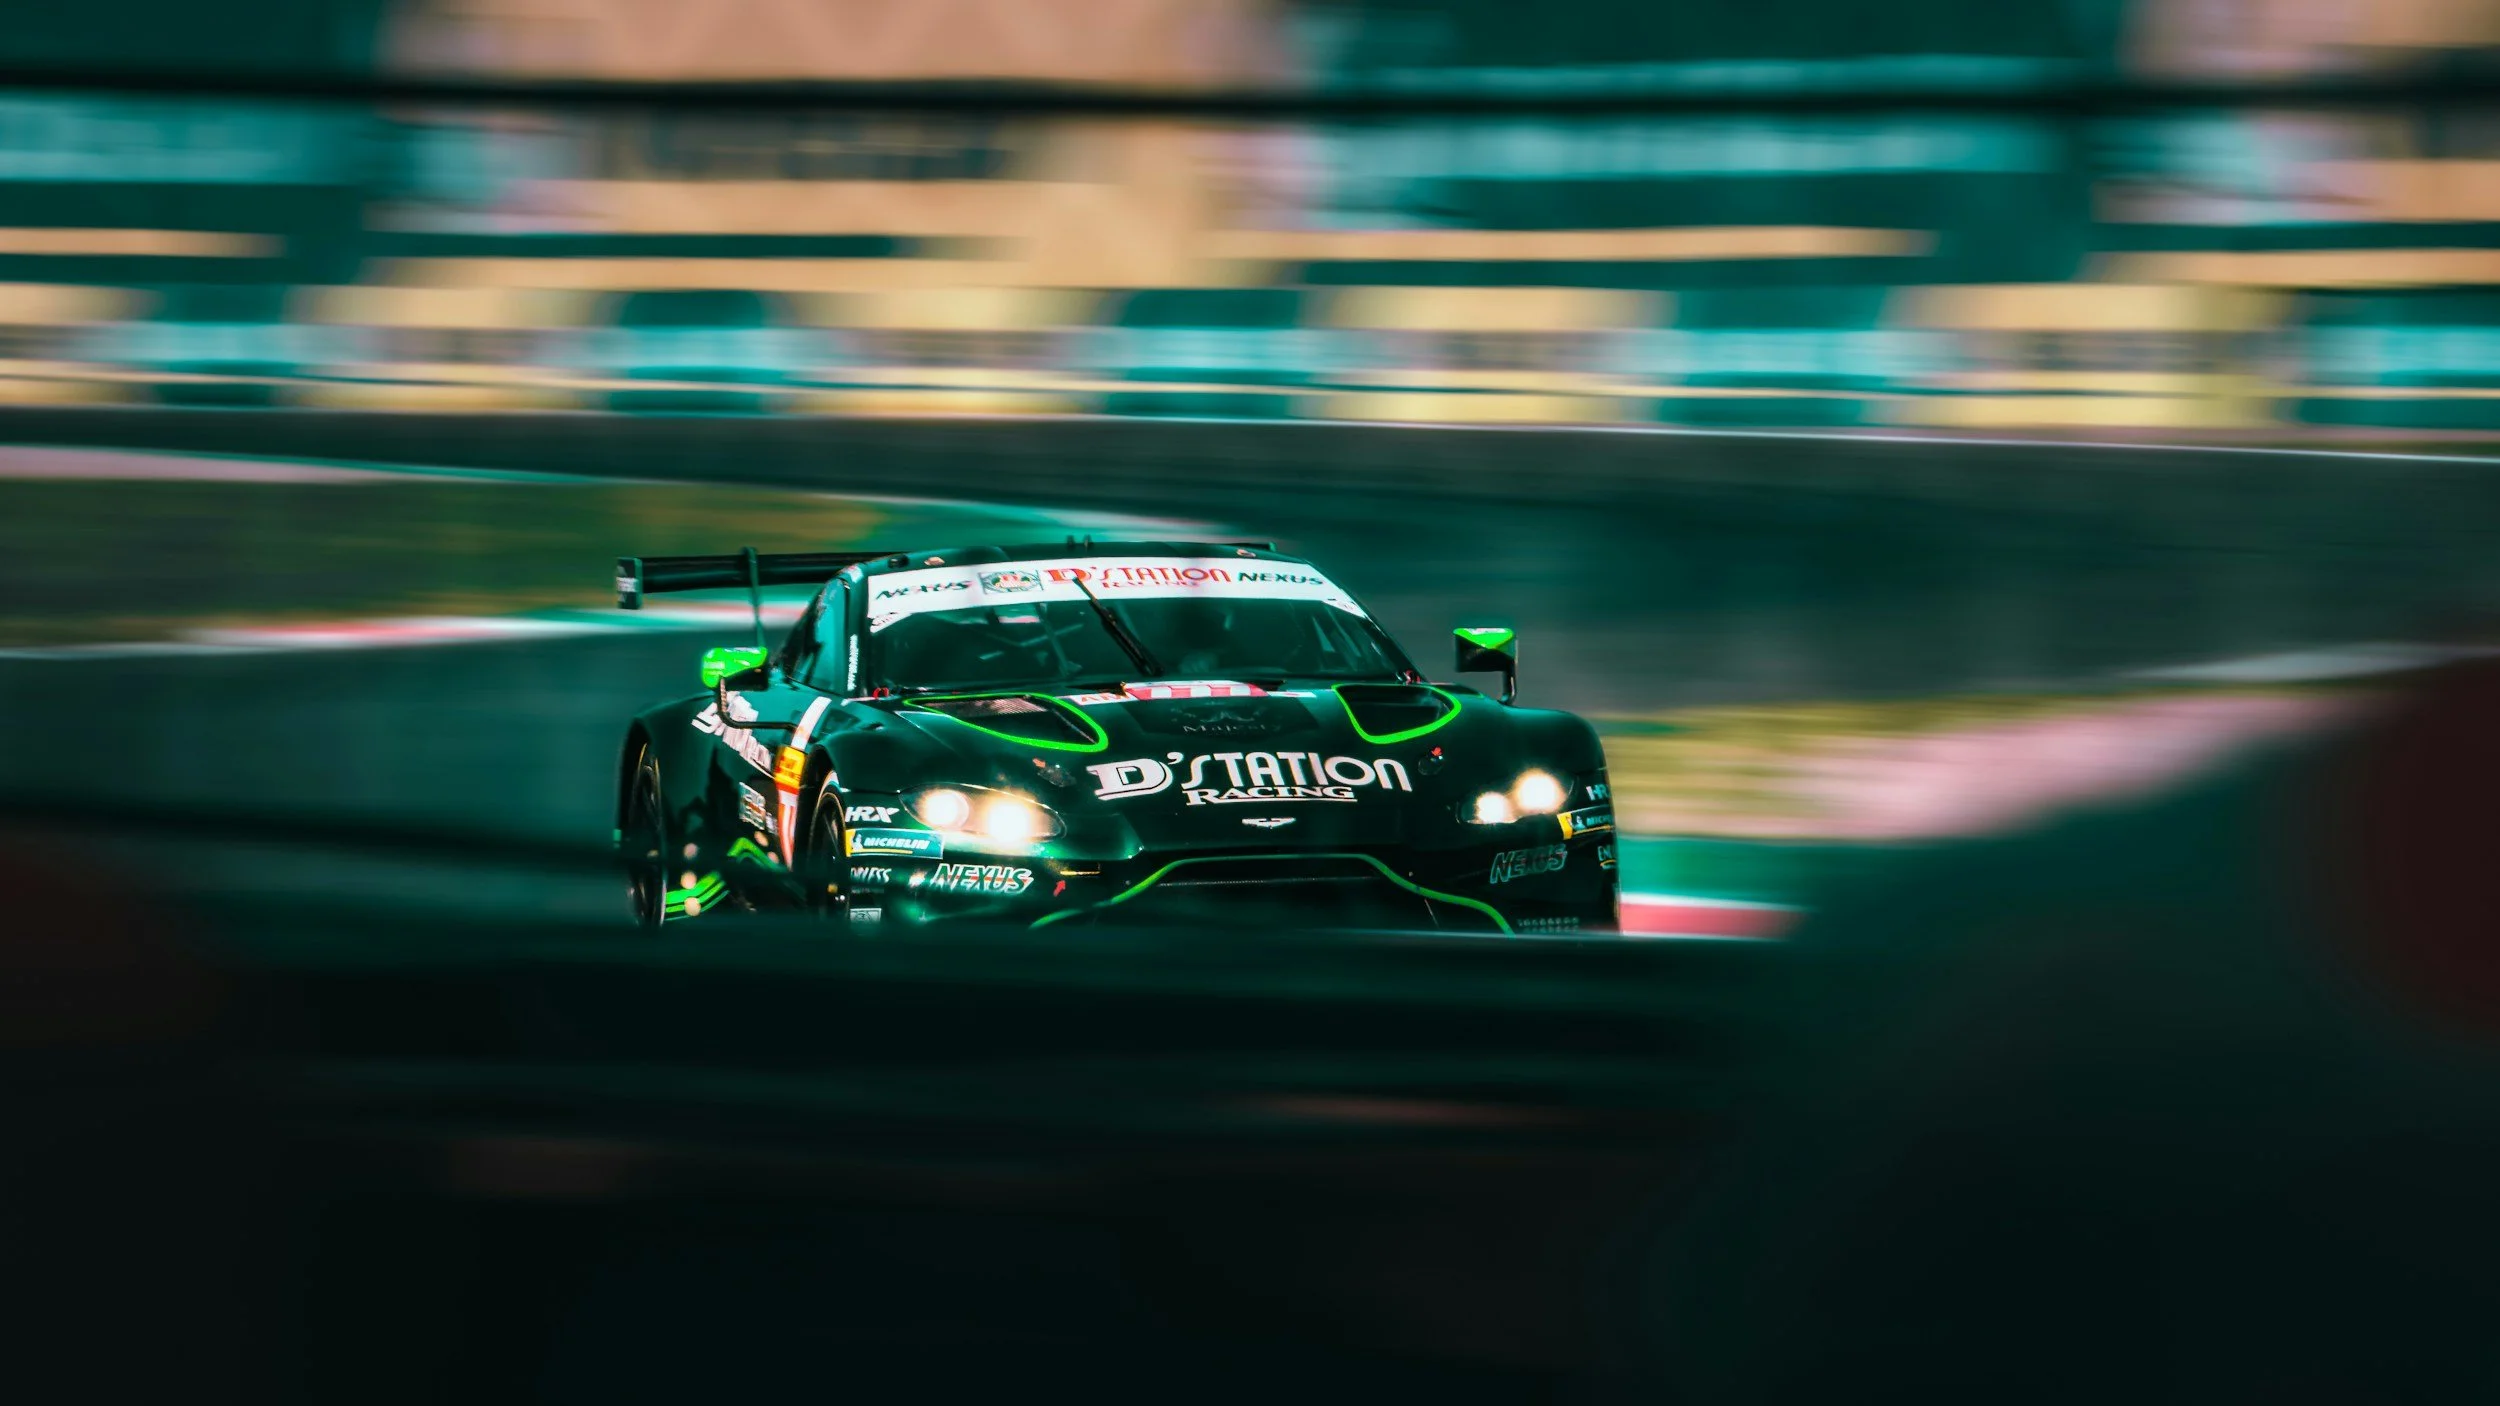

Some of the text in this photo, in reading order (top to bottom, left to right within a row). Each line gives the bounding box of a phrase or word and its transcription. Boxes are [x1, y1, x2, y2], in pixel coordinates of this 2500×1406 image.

[1238, 572, 1323, 585] NEXUS
[1086, 752, 1412, 800] D'STATION
[1182, 786, 1357, 806] RACING
[845, 806, 899, 823] HRX
[864, 837, 930, 850] MICHELIN
[1490, 843, 1568, 884] NEXUS
[931, 863, 1034, 894] NEXUS
